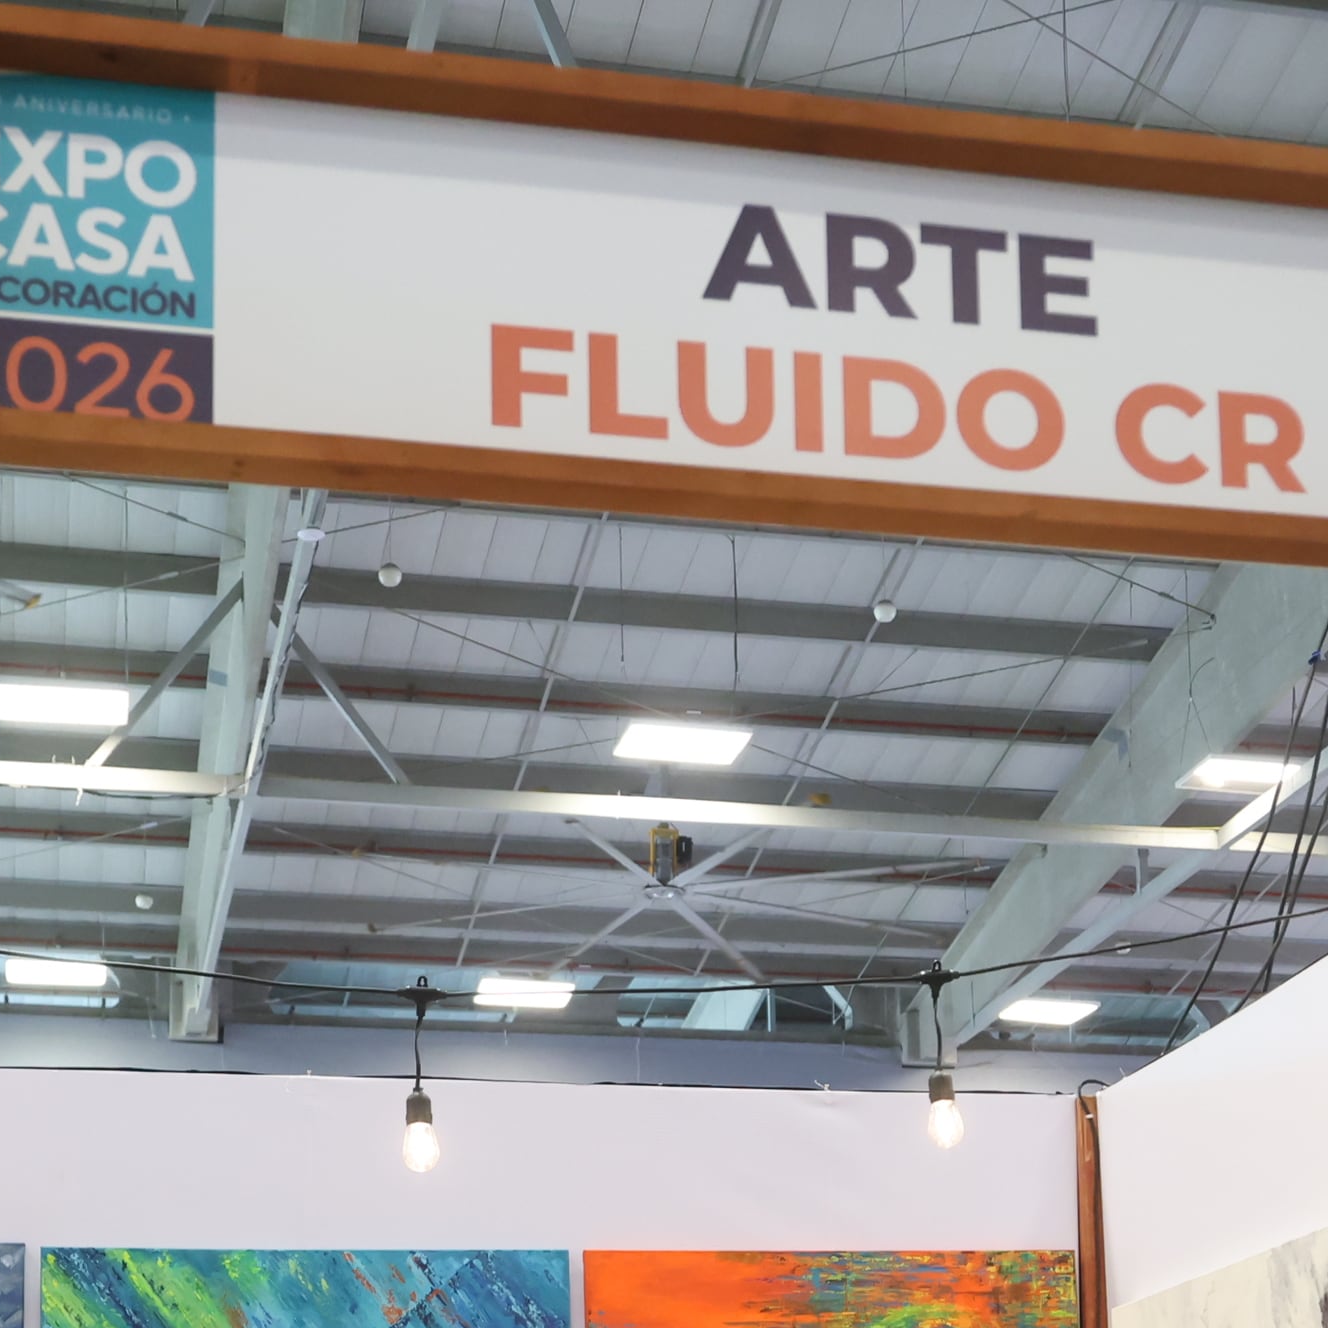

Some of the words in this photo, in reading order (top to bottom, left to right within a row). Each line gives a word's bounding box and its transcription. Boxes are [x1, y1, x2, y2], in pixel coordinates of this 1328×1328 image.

[13, 94, 173, 124] ANIVERSARIO
[702, 203, 1099, 336] ARTE
[490, 324, 1065, 471] FLUIDO
[1115, 383, 1307, 494] CR
